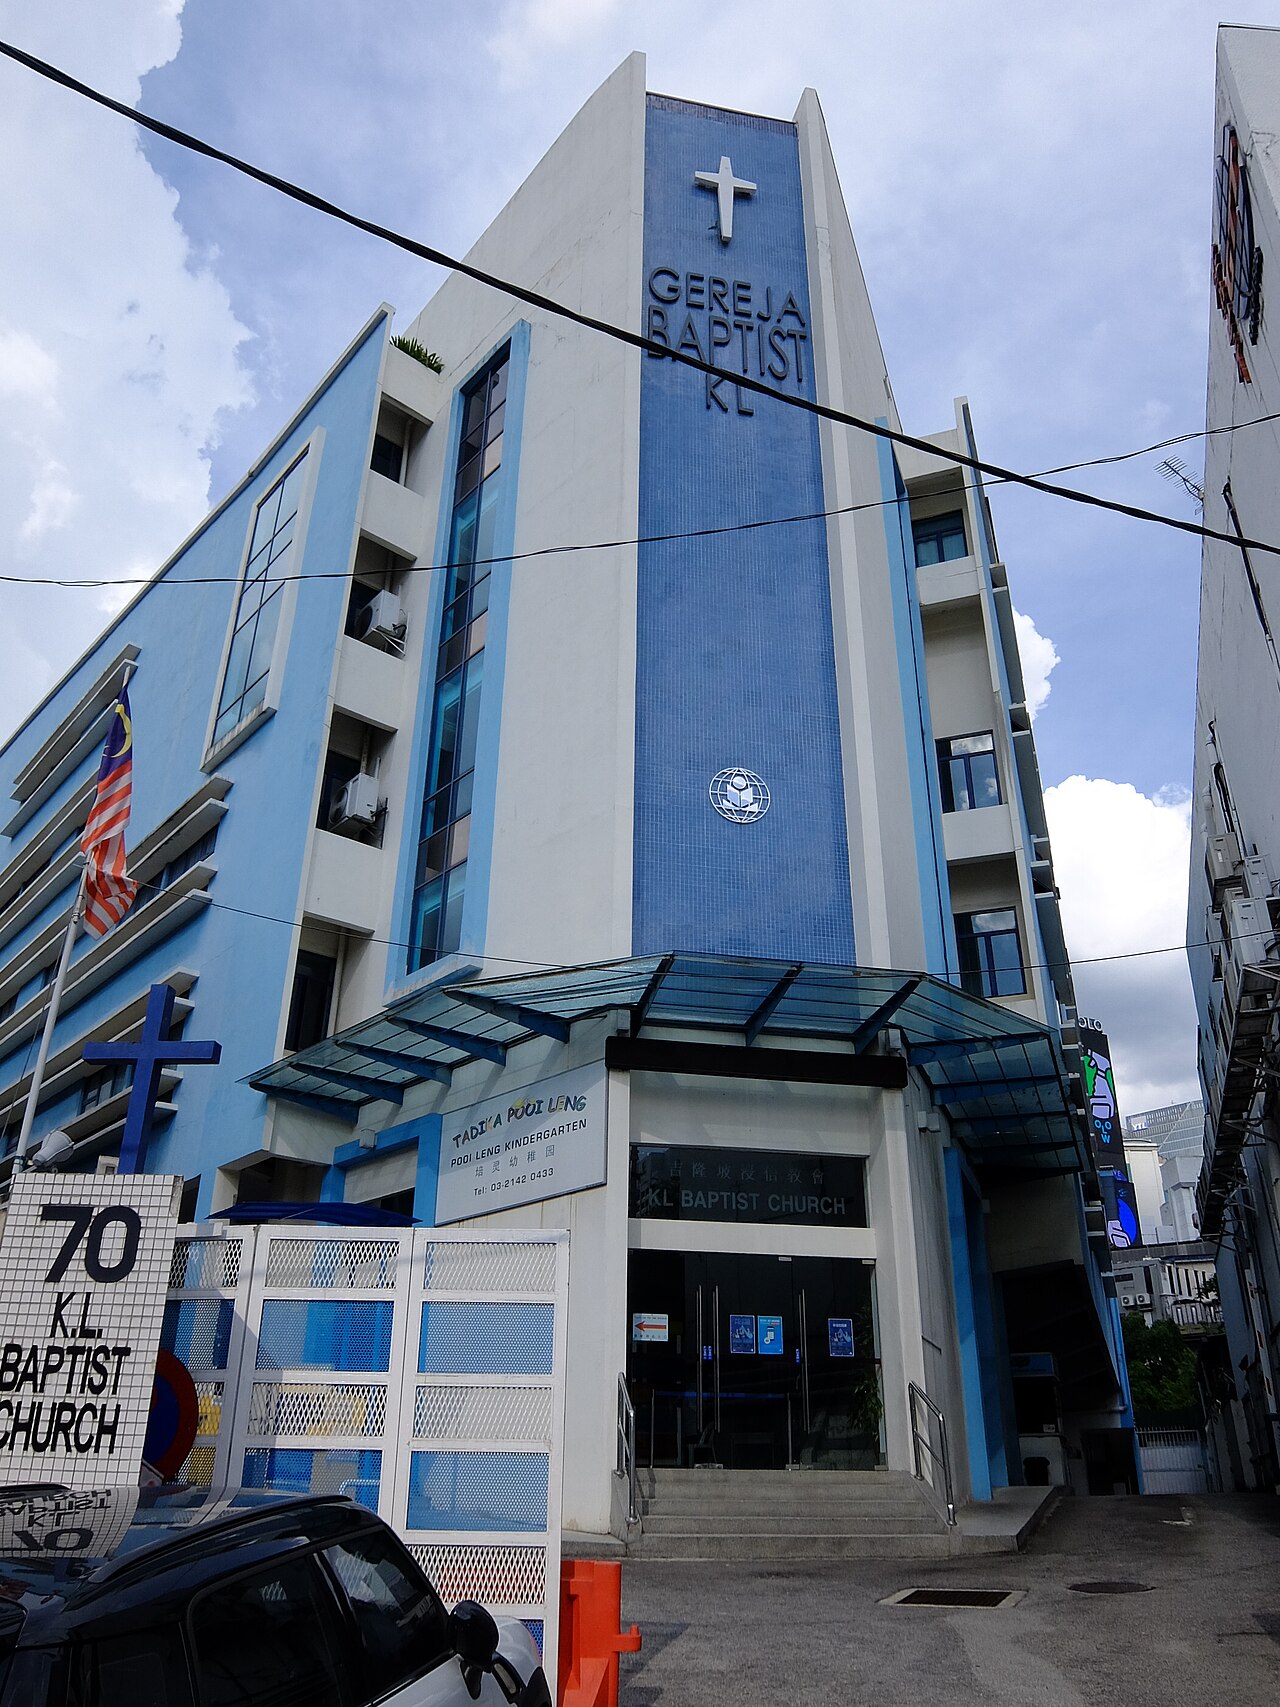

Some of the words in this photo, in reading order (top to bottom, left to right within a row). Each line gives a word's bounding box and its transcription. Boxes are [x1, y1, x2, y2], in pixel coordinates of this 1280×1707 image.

[649, 267, 806, 327] GEREJA
[647, 304, 807, 383] BAPTIST
[706, 370, 754, 416] KL
[451, 1153, 472, 1168] POOI
[476, 1144, 501, 1161] LENG
[505, 1118, 587, 1152] KINDERGARTEN
[453, 1114, 502, 1148] TADIKA
[508, 1099, 543, 1122] POOI
[548, 1095, 587, 1114] LENG
[474, 1187, 488, 1197] Tel:
[491, 1174, 527, 1192] 03-2142
[530, 1168, 554, 1181] 0433
[649, 1188, 674, 1207] KL
[681, 1189, 760, 1211] BAPTIST
[768, 1193, 846, 1215] CHURCH
[40, 1204, 142, 1284] 70
[50, 1292, 104, 1339] K.L.
[0, 1343, 131, 1395] BAPTIST
